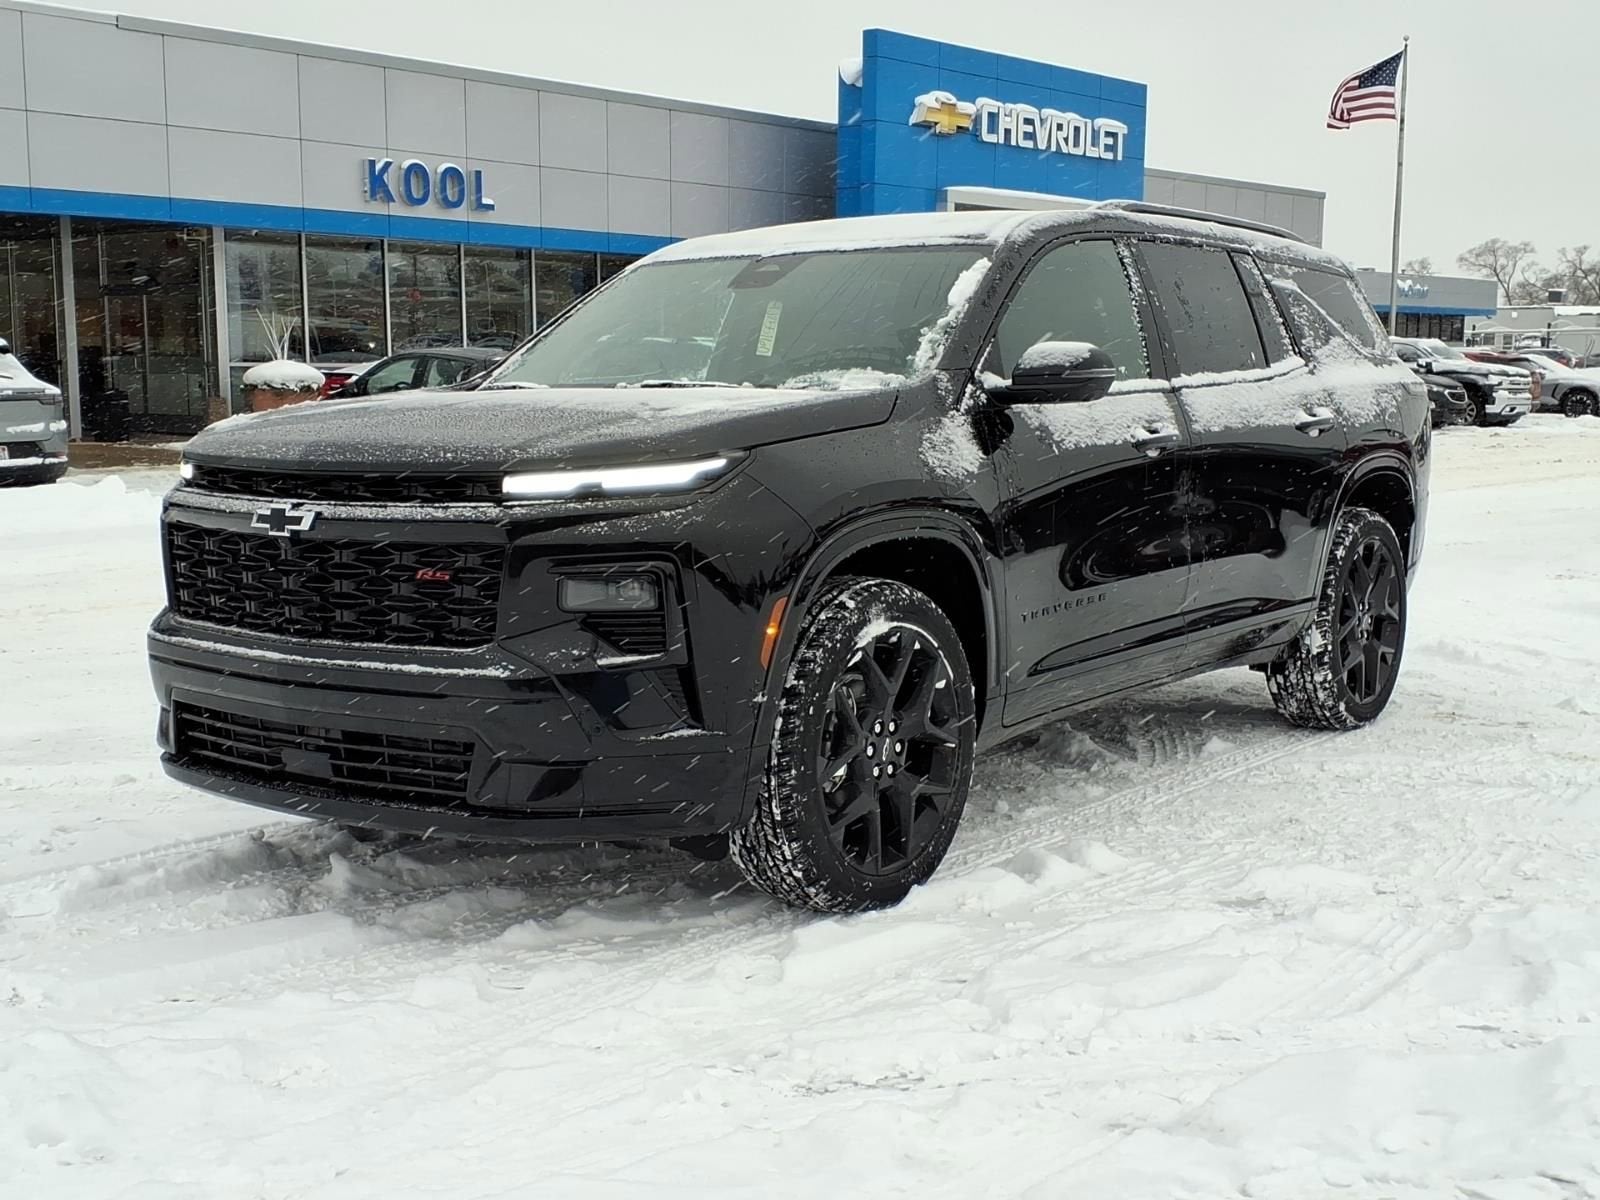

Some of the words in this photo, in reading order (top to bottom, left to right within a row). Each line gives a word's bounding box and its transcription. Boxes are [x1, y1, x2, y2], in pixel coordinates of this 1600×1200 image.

[977, 98, 1128, 161] CHEVROLET
[363, 157, 496, 212] KOOL
[416, 567, 449, 580] RS
[1020, 593, 1107, 623] TRAVERSE
